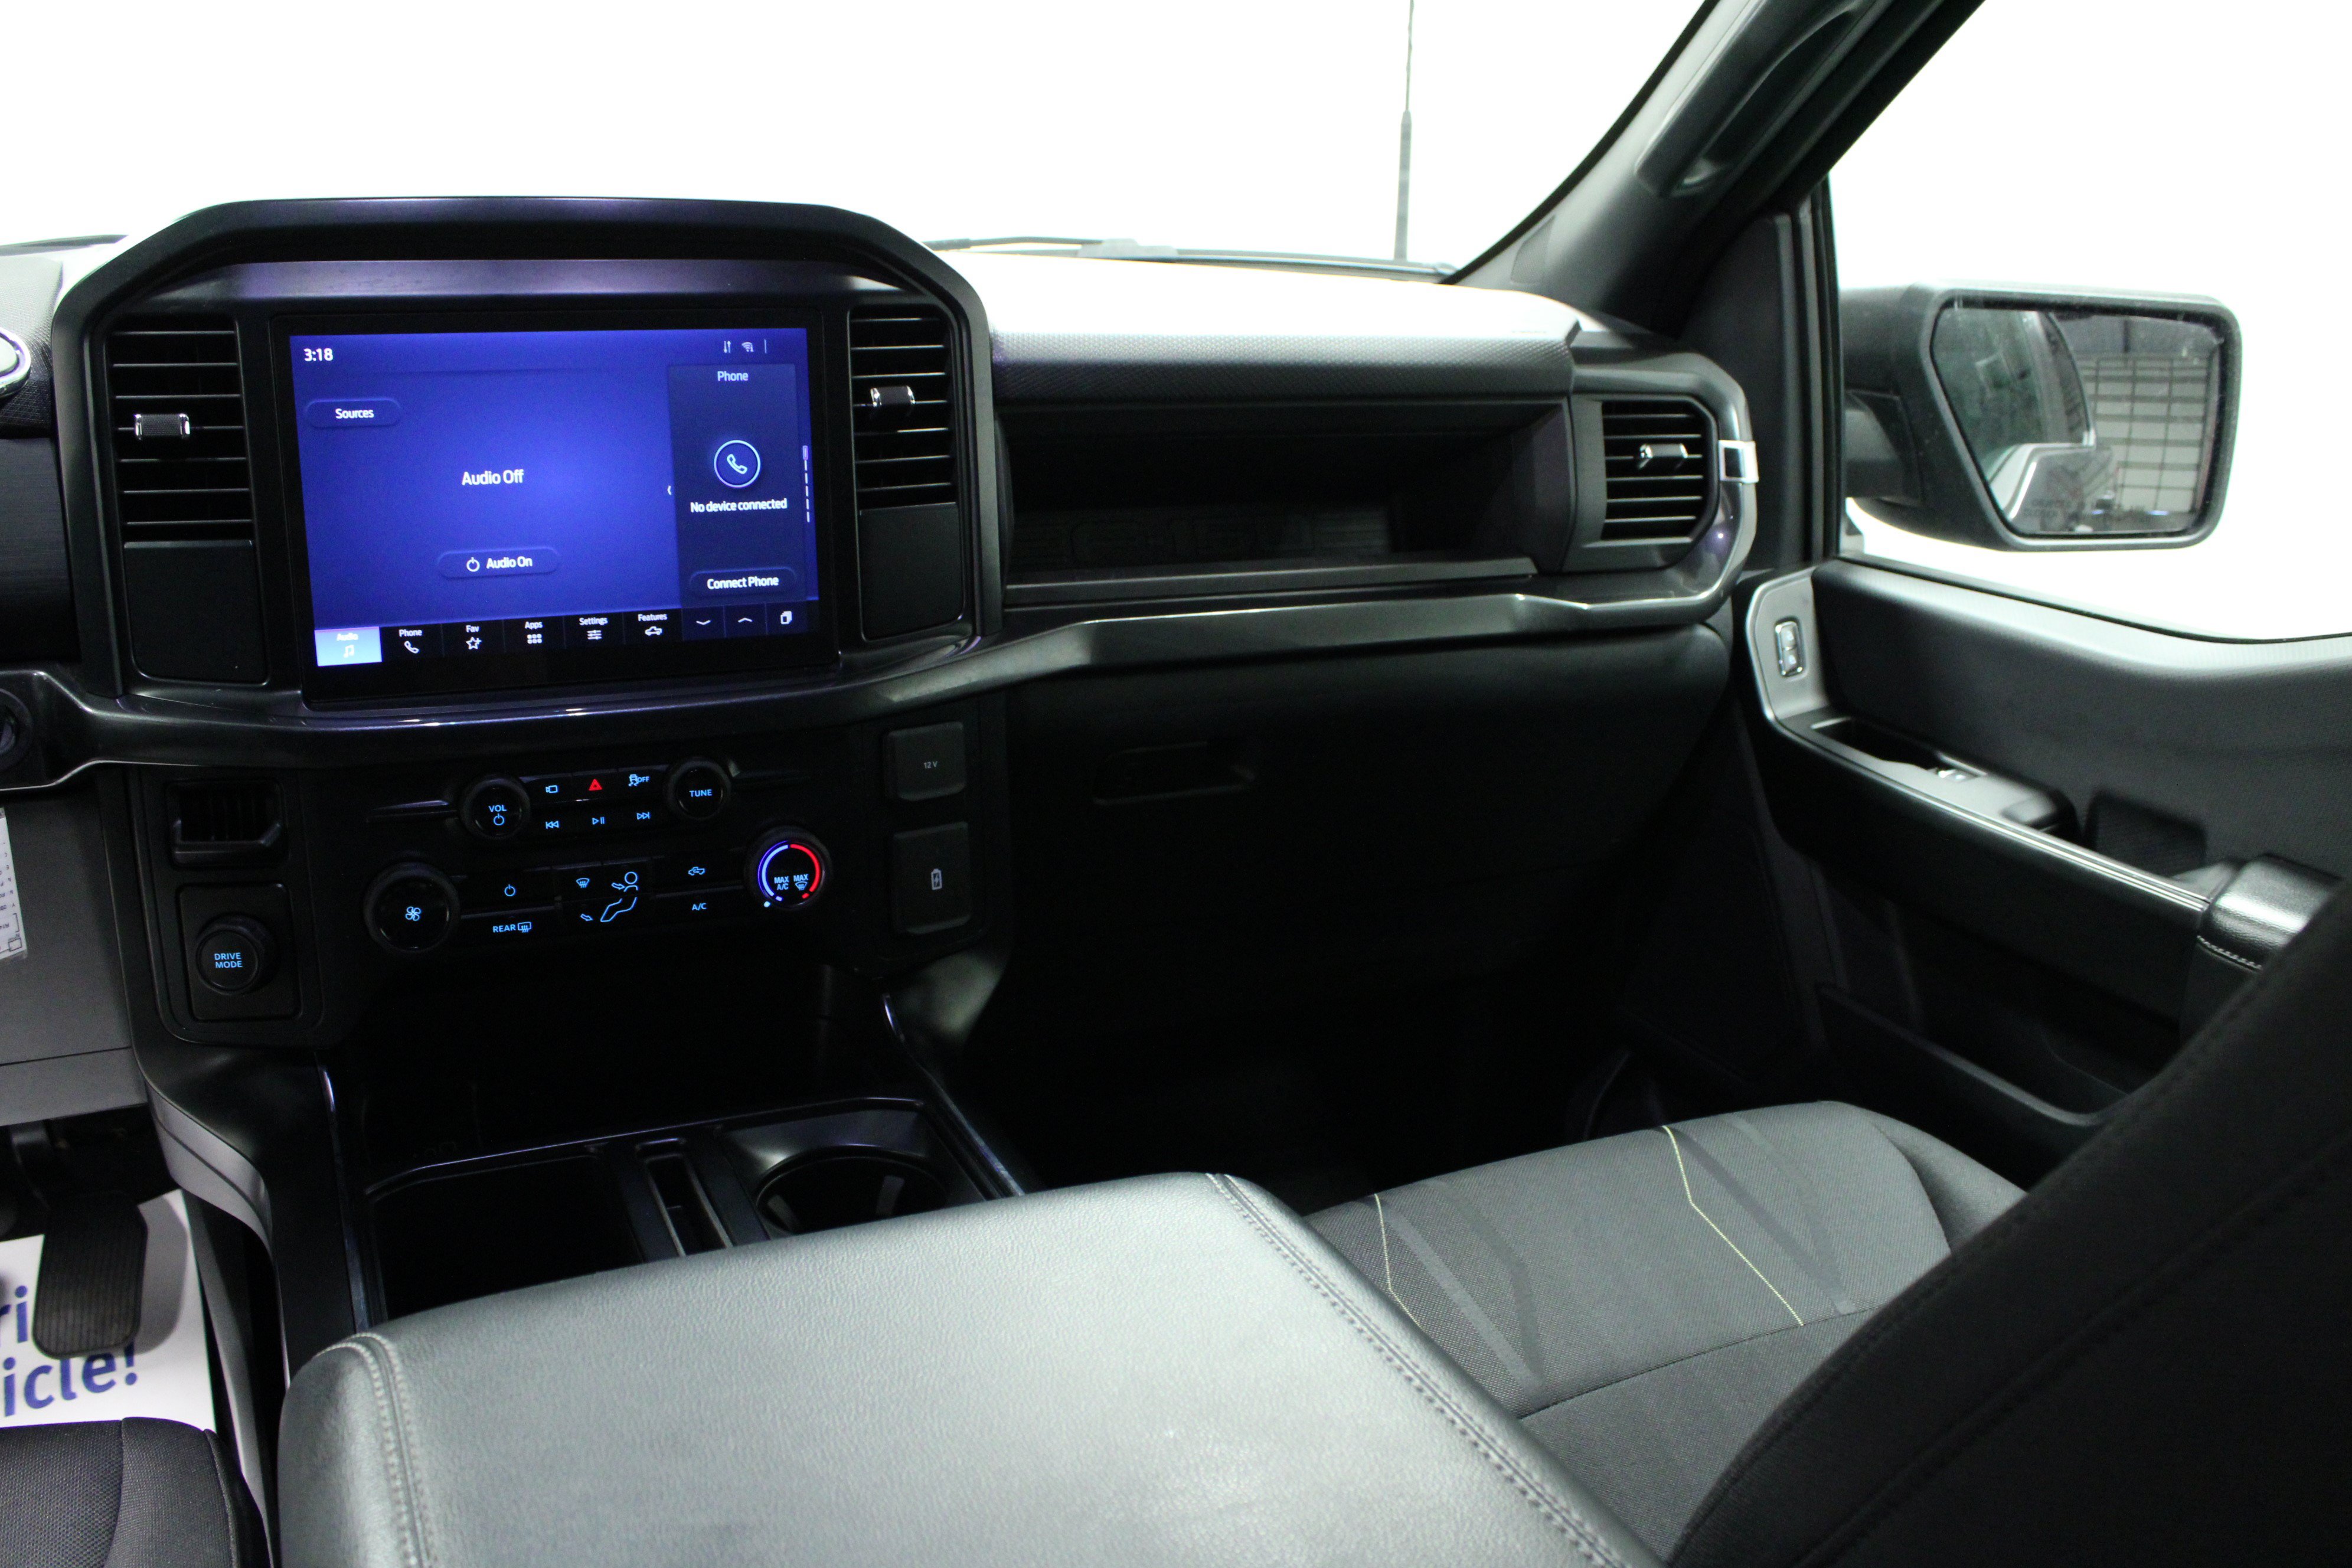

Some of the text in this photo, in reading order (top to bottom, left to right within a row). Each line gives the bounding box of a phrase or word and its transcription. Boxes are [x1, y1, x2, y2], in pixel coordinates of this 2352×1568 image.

[303, 348, 334, 362] 3:18
[717, 370, 749, 381] Phone
[335, 408, 374, 419] Sources
[462, 469, 524, 485] Audio Off
[690, 498, 788, 513] No device connected
[486, 556, 533, 570] Audio On
[707, 576, 779, 590] Connect Phone
[579, 617, 608, 626] Settings
[638, 613, 668, 622] Features
[466, 625, 480, 633] Fav
[524, 621, 543, 630] Apps
[336, 632, 359, 642] Audio
[398, 629, 423, 638] Phone
[637, 775, 650, 783] OFF
[689, 789, 713, 798] TUNE
[488, 804, 507, 813] VOL
[793, 874, 809, 882] MAX
[691, 903, 707, 911] A/C
[492, 924, 516, 933] REAR
[214, 952, 241, 961] DRIVE
[215, 961, 243, 969] MODE
